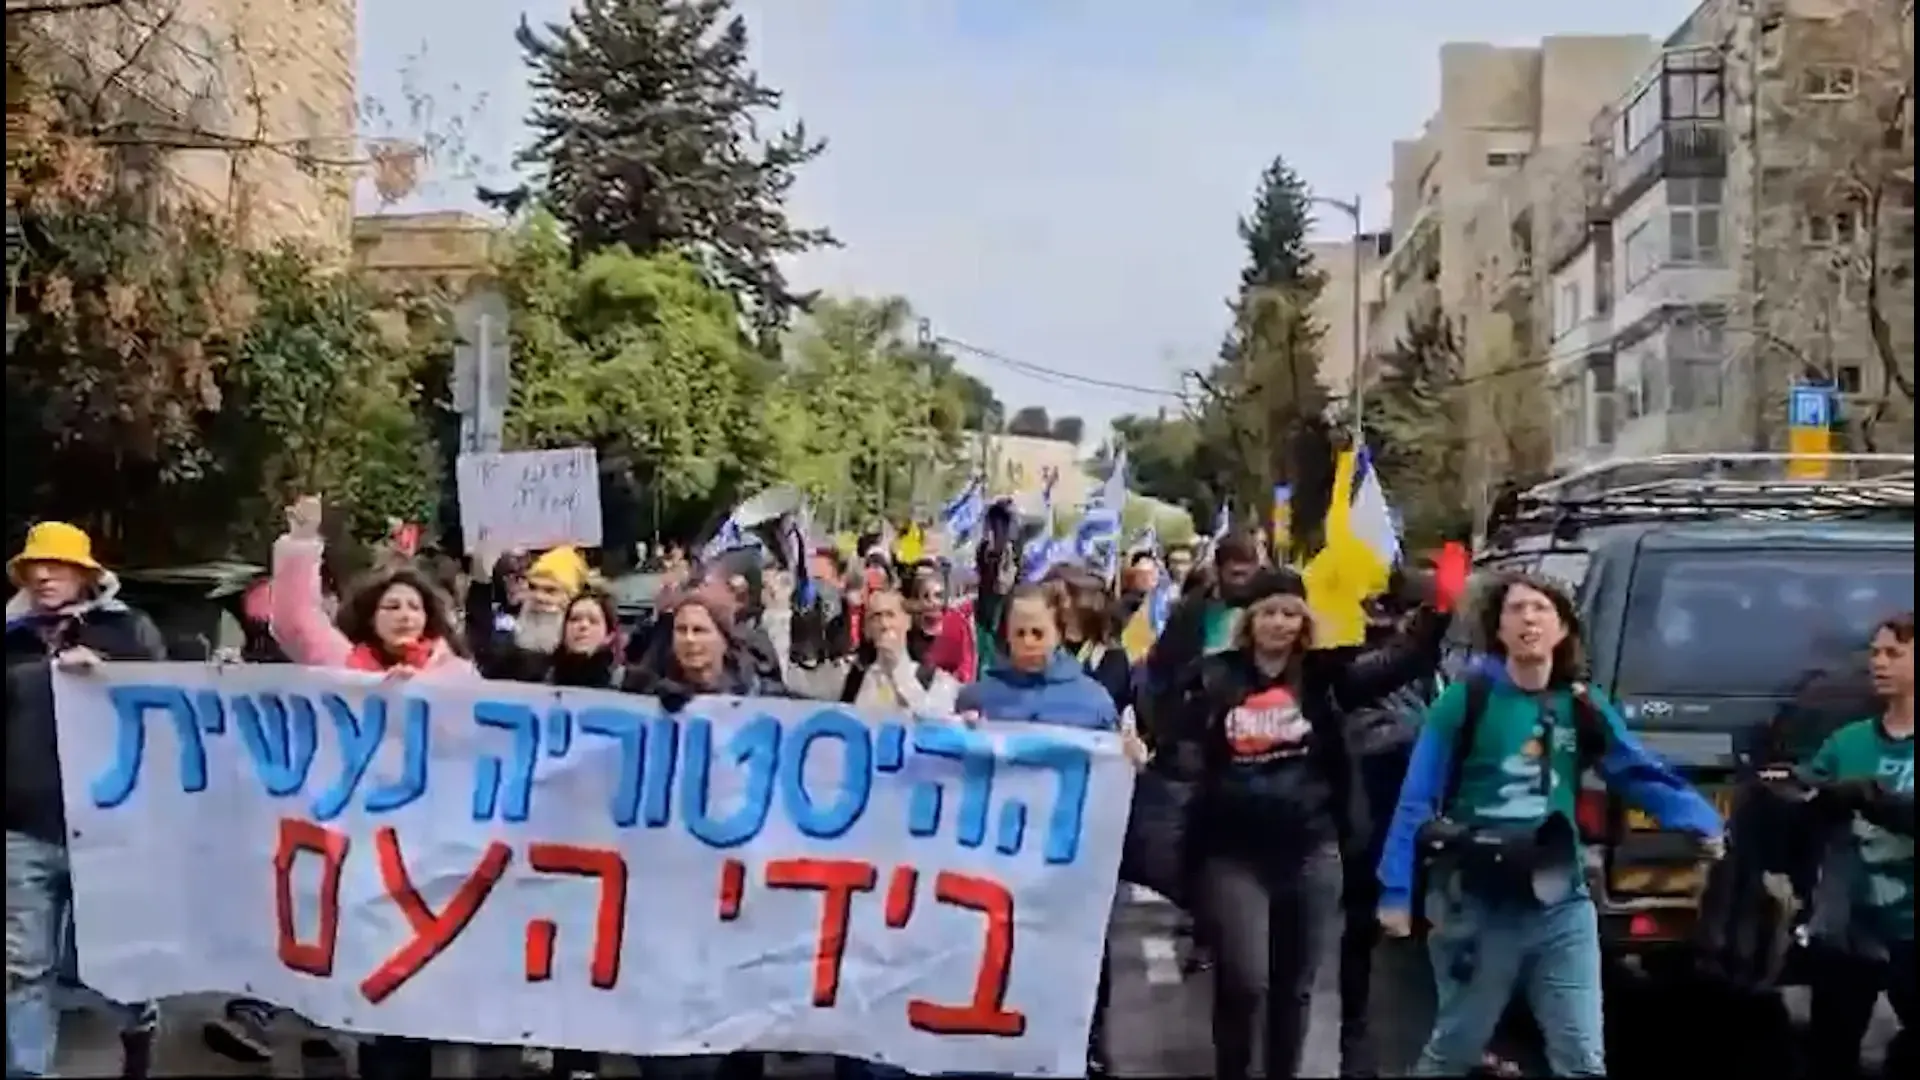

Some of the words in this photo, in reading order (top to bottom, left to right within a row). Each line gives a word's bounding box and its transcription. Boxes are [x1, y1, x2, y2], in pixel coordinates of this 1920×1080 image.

[92, 684, 430, 820] נעשית
[472, 701, 1091, 864] ההיסטוריה
[273, 818, 628, 1004] העם
[718, 857, 1026, 1037] בידי
